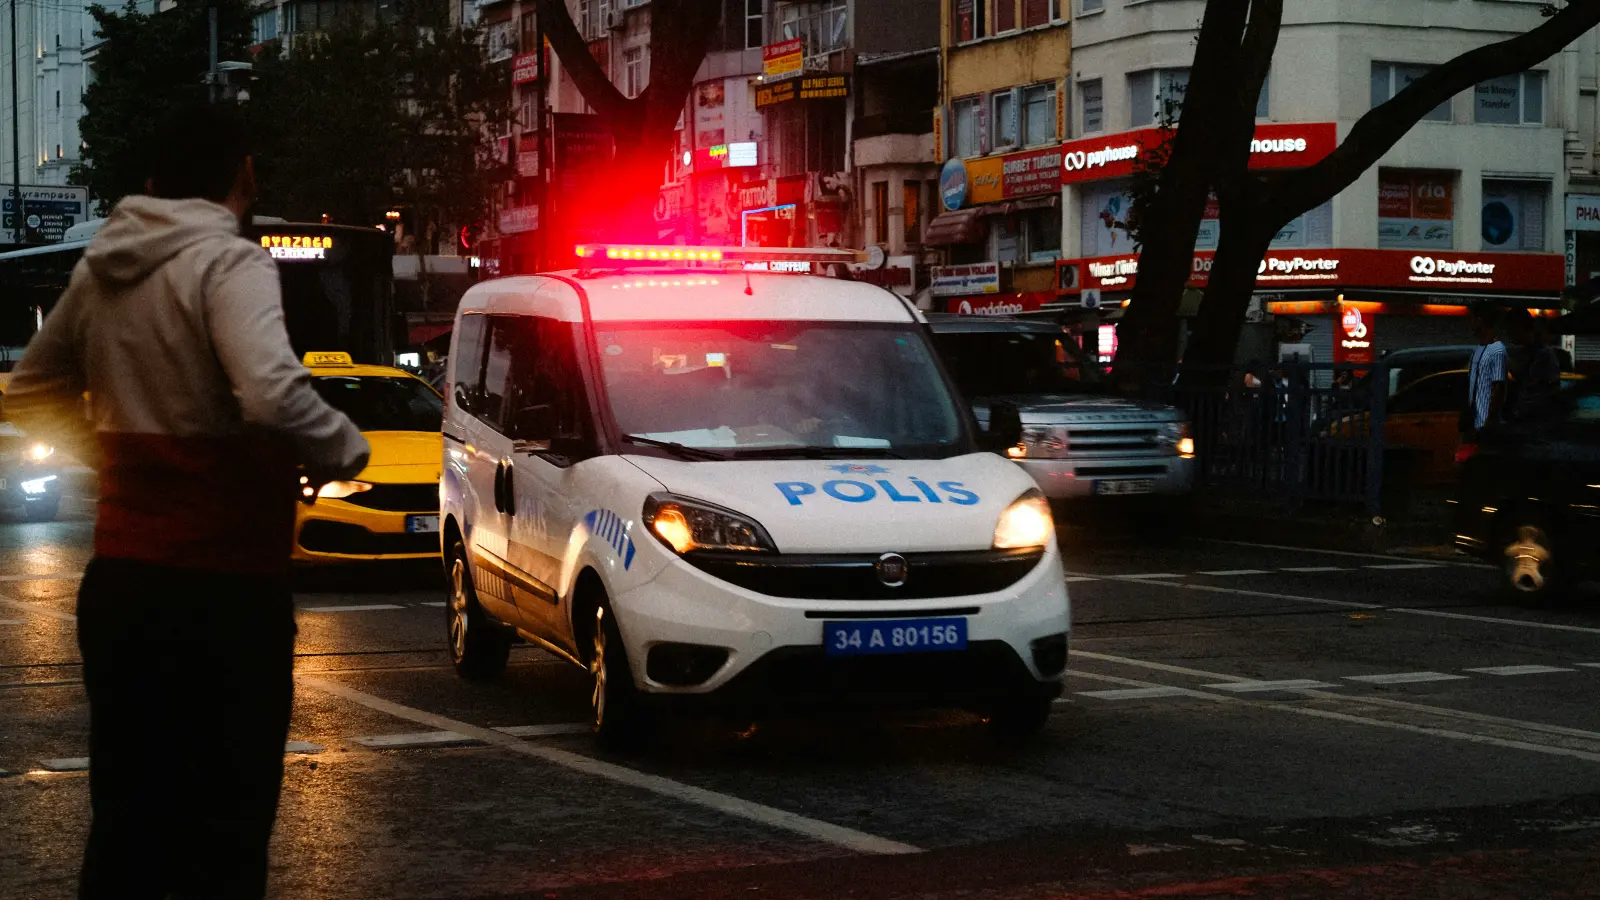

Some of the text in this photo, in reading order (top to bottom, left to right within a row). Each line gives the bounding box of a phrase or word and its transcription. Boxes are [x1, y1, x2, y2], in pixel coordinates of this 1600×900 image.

[1250, 137, 1307, 153] house
[1087, 145, 1138, 168] payhouse
[8, 188, 77, 200] Byrampaşa
[1268, 257, 1339, 273] PayPorter
[1436, 259, 1496, 275] PayPorter
[774, 476, 980, 506] POLİS
[835, 625, 959, 650] 34 A 80156
